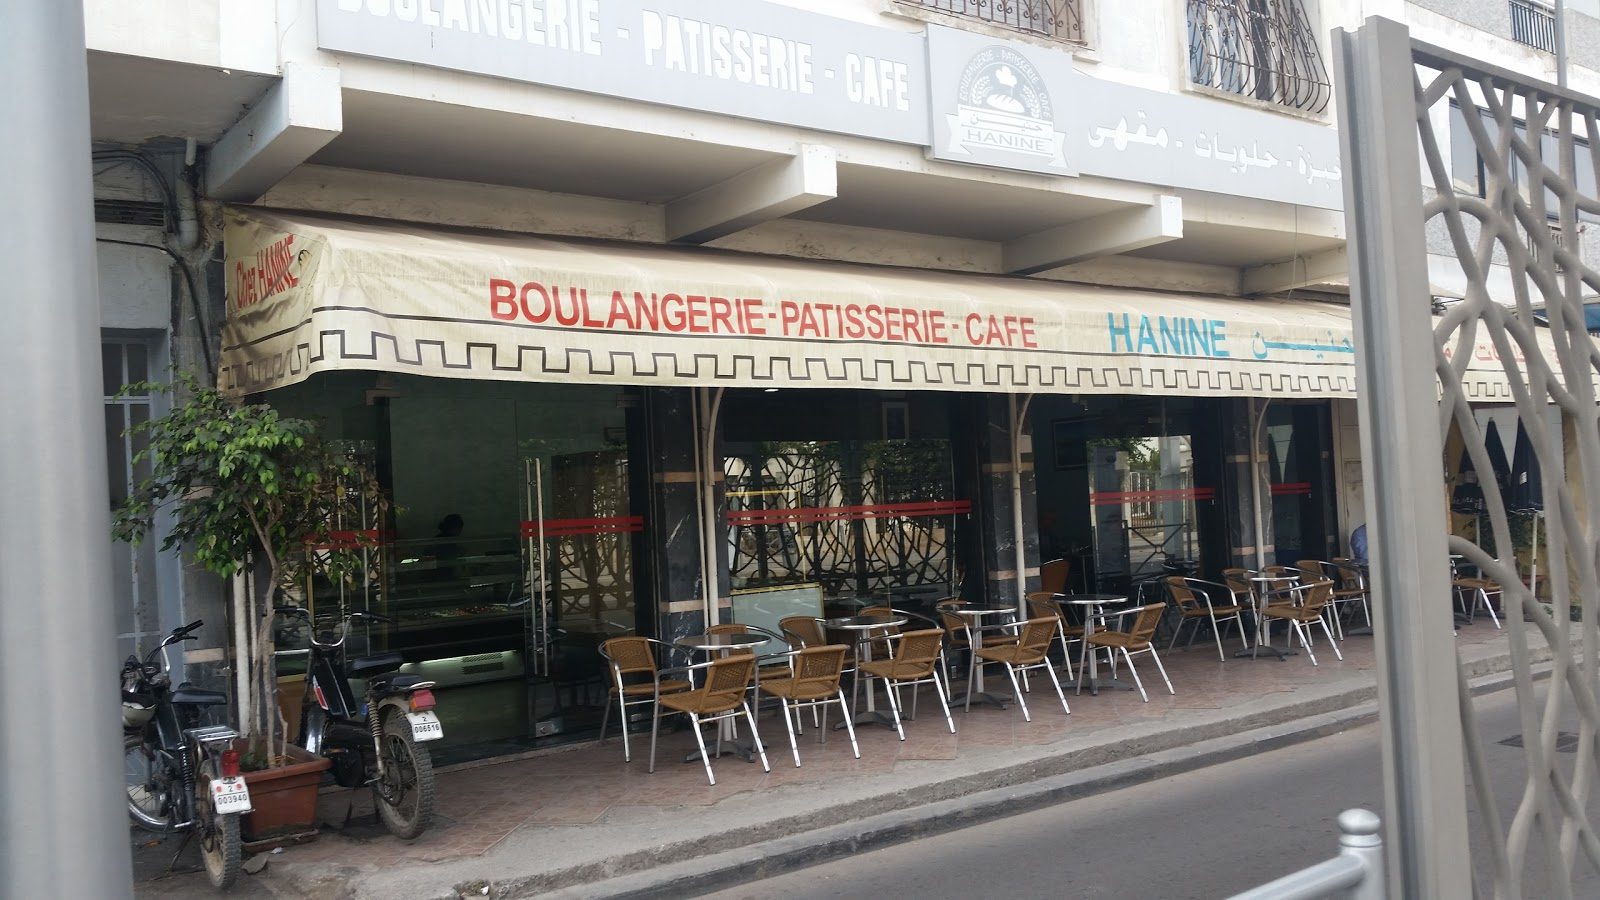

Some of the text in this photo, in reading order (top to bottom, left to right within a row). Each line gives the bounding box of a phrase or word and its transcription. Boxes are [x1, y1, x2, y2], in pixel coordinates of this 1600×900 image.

[641, 9, 815, 94] PATISSERIE
[845, 51, 910, 112] CAFE
[967, 129, 1045, 151] HANINE
[1194, 128, 1279, 175] حلويات
[1108, 312, 1230, 357] HANINE
[217, 793, 248, 805] 003940
[227, 785, 233, 793] 2
